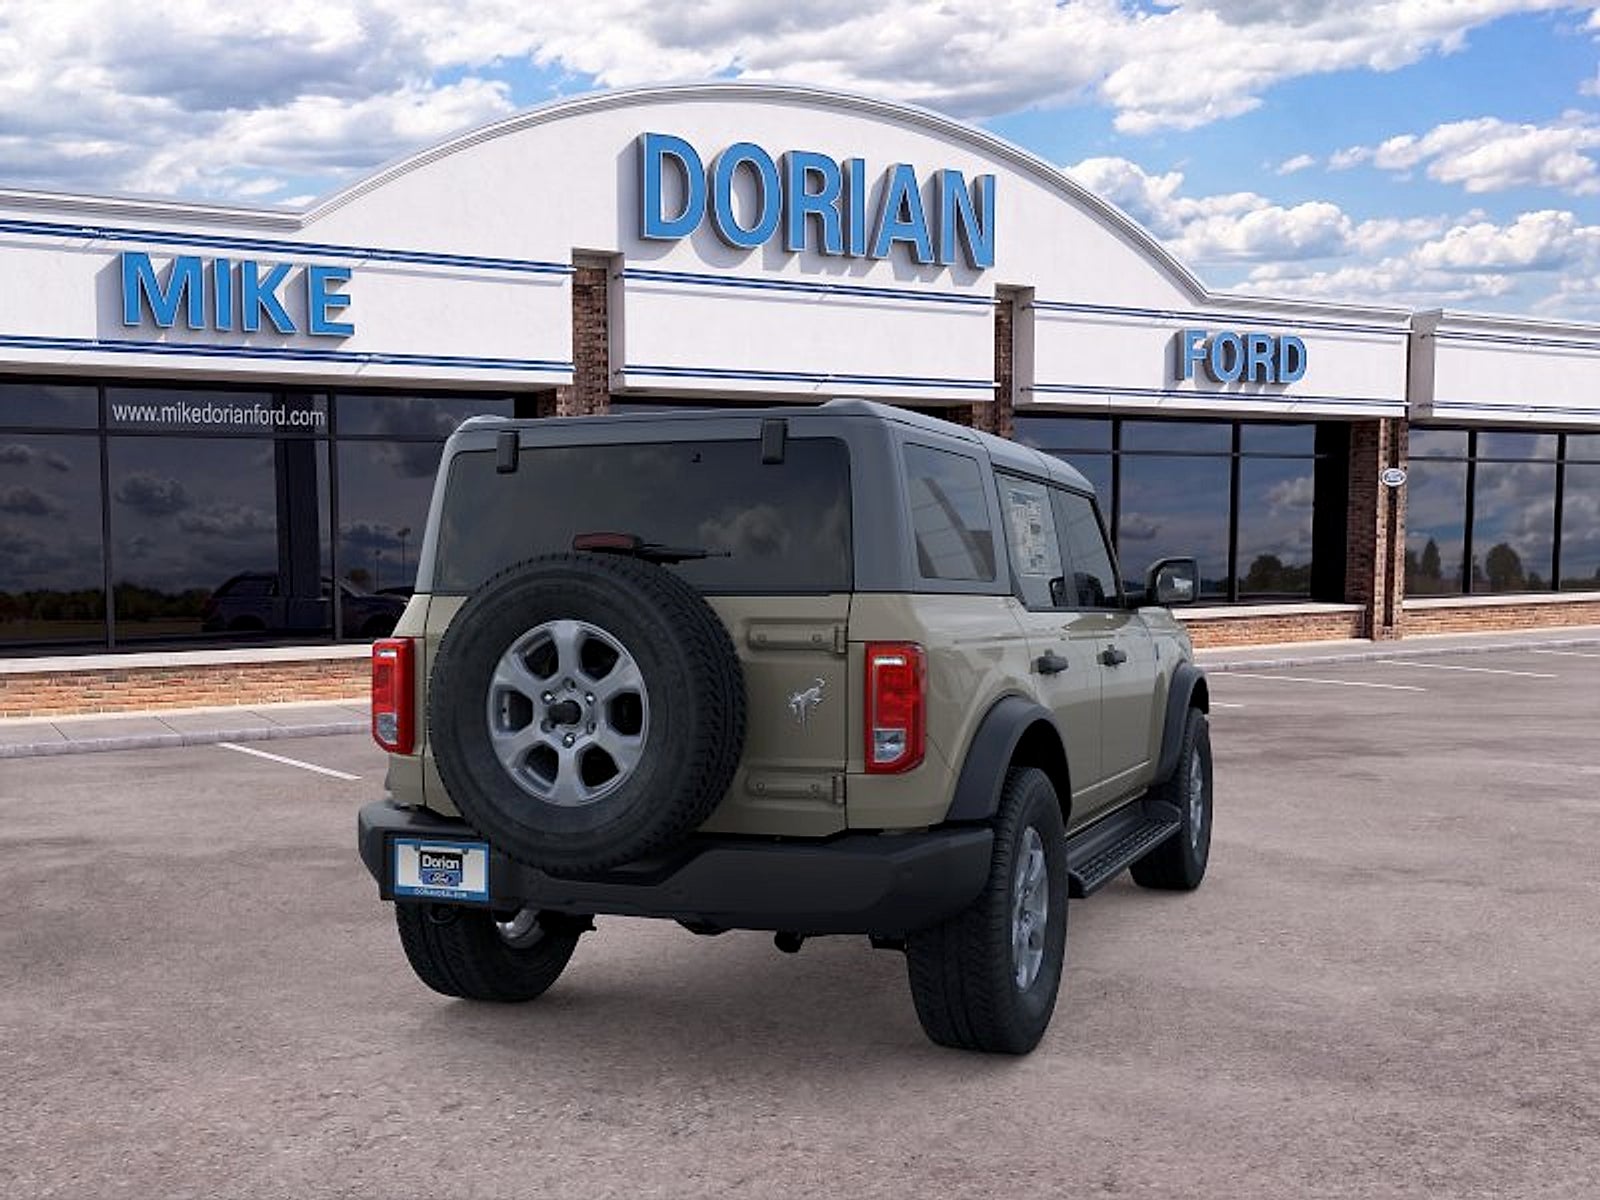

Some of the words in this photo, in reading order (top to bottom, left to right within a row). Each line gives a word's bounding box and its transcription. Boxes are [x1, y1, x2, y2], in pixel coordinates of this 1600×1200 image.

[640, 132, 995, 270] DORIAN
[121, 251, 355, 337] MIKE
[1182, 328, 1307, 384] FORD
[112, 402, 326, 426] www.mikedorianford.com
[422, 854, 459, 869] Dorian
